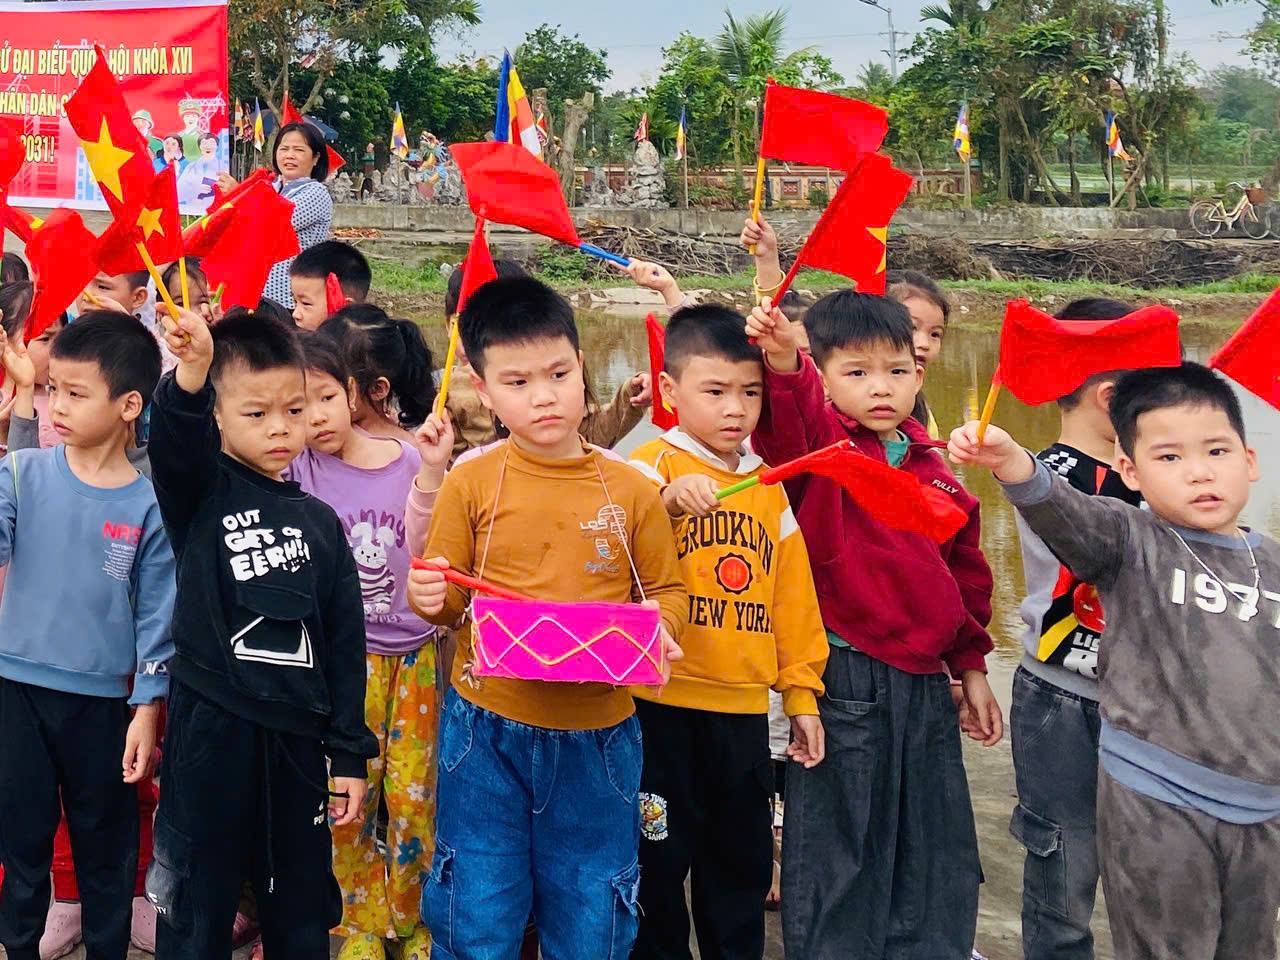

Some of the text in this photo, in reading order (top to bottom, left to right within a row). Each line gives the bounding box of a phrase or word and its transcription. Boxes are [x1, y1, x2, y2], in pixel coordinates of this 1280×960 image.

[13, 48, 35, 80] ĐẠI
[37, 39, 67, 76] BIỂU
[71, 40, 98, 78] QUỐ
[108, 43, 130, 81] HỘI
[133, 42, 169, 74] KHÓA
[171, 46, 193, 75] XVI
[32, 88, 56, 117] DÂN
[222, 509, 260, 531] OUT
